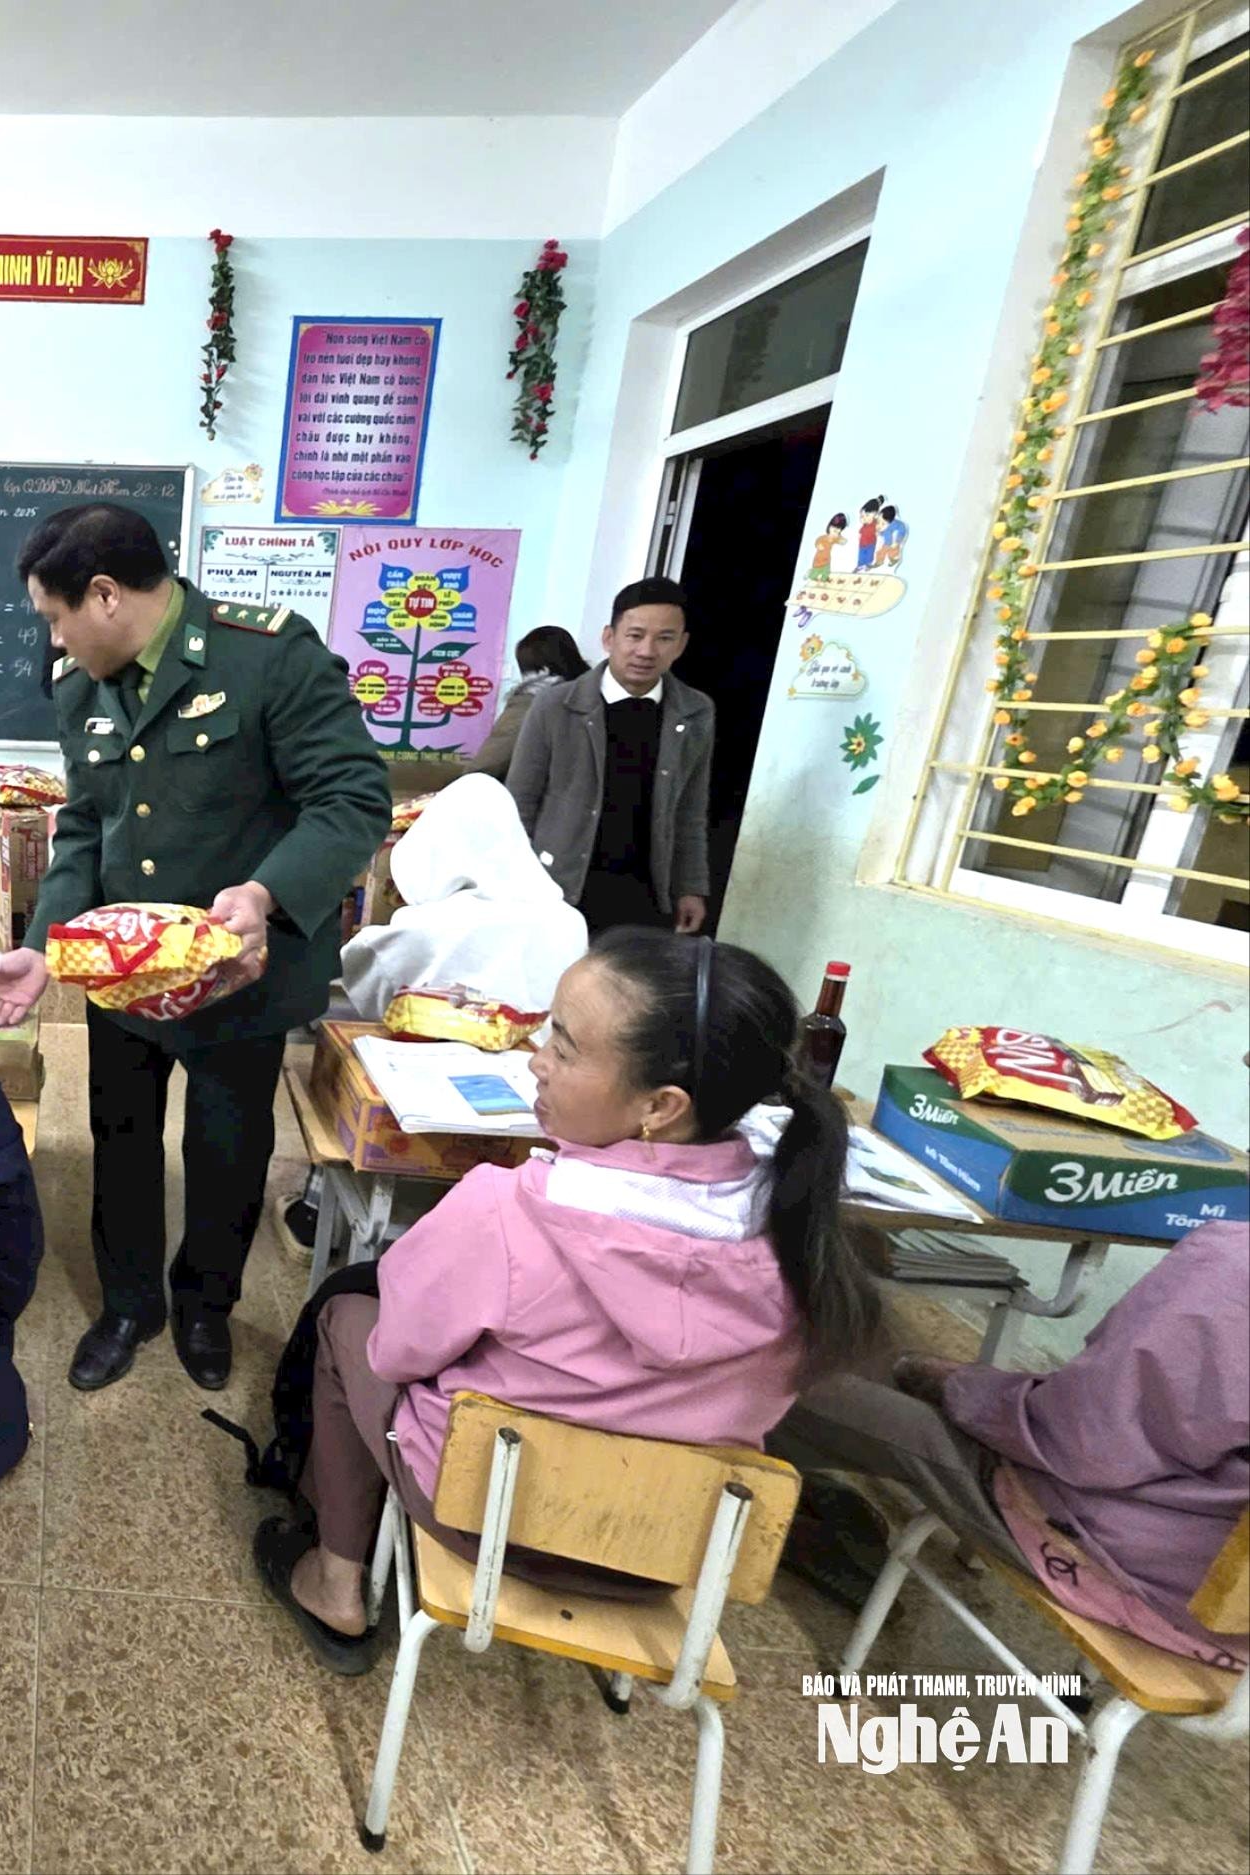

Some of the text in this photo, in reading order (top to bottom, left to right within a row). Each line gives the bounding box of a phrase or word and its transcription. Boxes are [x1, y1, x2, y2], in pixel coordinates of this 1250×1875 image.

[36, 250, 54, 286] VĨ
[56, 256, 84, 294] ĐẠI
[225, 536, 315, 549] LUẬT CHÍNH TẢ
[348, 538, 504, 568] NỘI QUY LỚP HỌC
[207, 568, 258, 577] PHỤ ÂM
[270, 570, 332, 578] NGUYÊN ÂM
[909, 1094, 960, 1126] 3 Miền
[1044, 1161, 1180, 1203] 3 Miền
[1199, 1204, 1227, 1218] Mì
